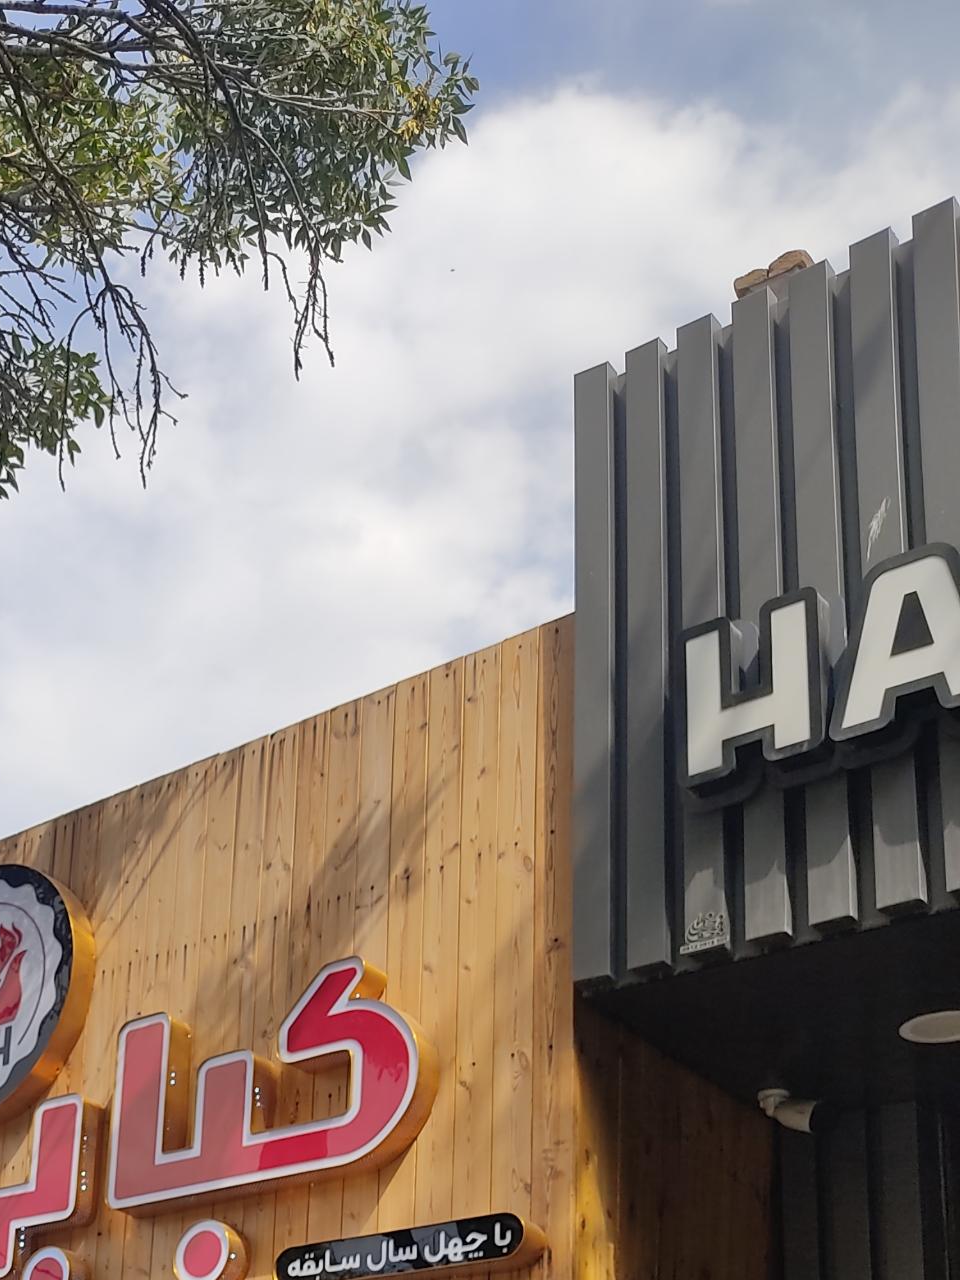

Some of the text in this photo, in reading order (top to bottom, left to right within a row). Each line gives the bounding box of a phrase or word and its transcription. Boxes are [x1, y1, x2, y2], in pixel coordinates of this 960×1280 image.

[494, 1221, 512, 1253] با
[287, 1249, 361, 1280] سابقه
[366, 1239, 418, 1272] سال
